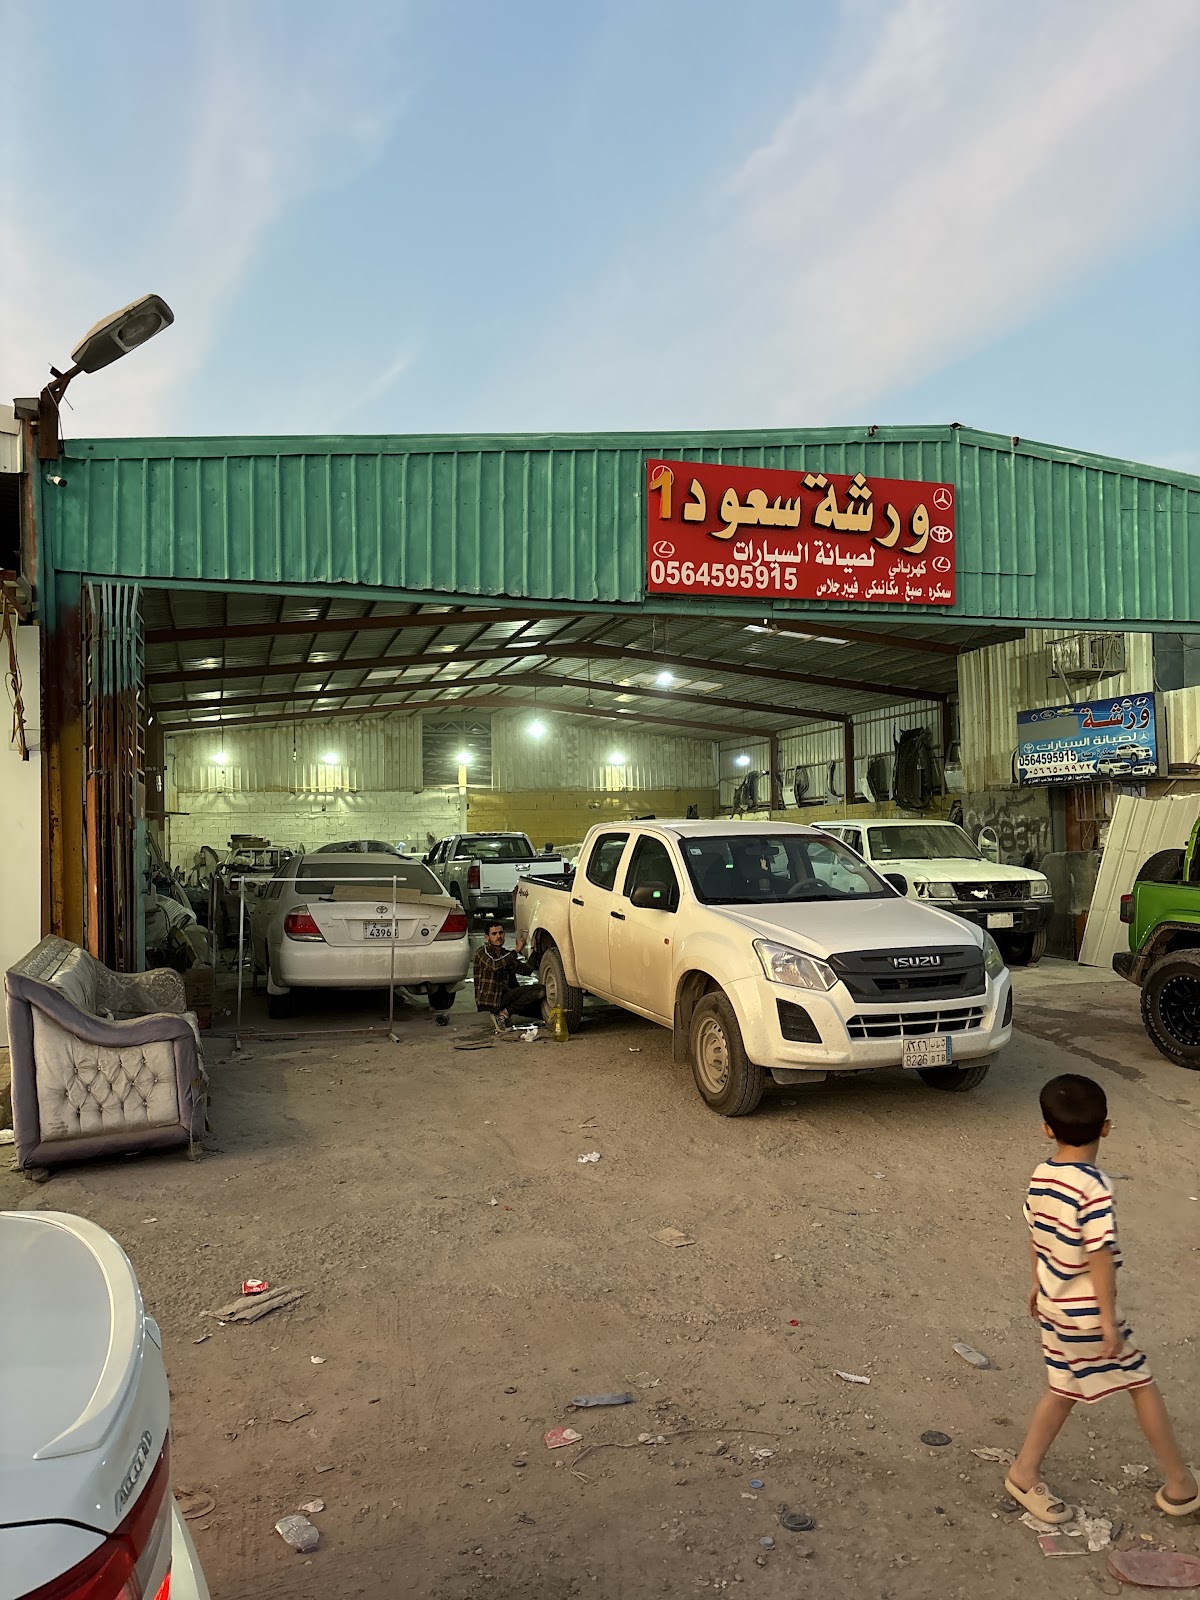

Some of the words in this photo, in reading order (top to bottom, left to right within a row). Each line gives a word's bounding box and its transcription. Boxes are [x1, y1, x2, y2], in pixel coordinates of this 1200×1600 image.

[650, 470, 672, 519] 1
[684, 478, 801, 540] سعود
[803, 472, 930, 554] ورشة
[733, 538, 809, 568] السيارات
[813, 540, 876, 574] لصيانة
[650, 559, 798, 591] 0564595915
[904, 581, 923, 602] صبغ
[1080, 703, 1150, 730] ورشة
[1036, 737, 1090, 753] السيارات
[1093, 732, 1137, 748] لصيانة
[1019, 750, 1077, 767] 0564595915
[893, 955, 941, 969] ISUZU
[906, 1053, 928, 1067] 8226
